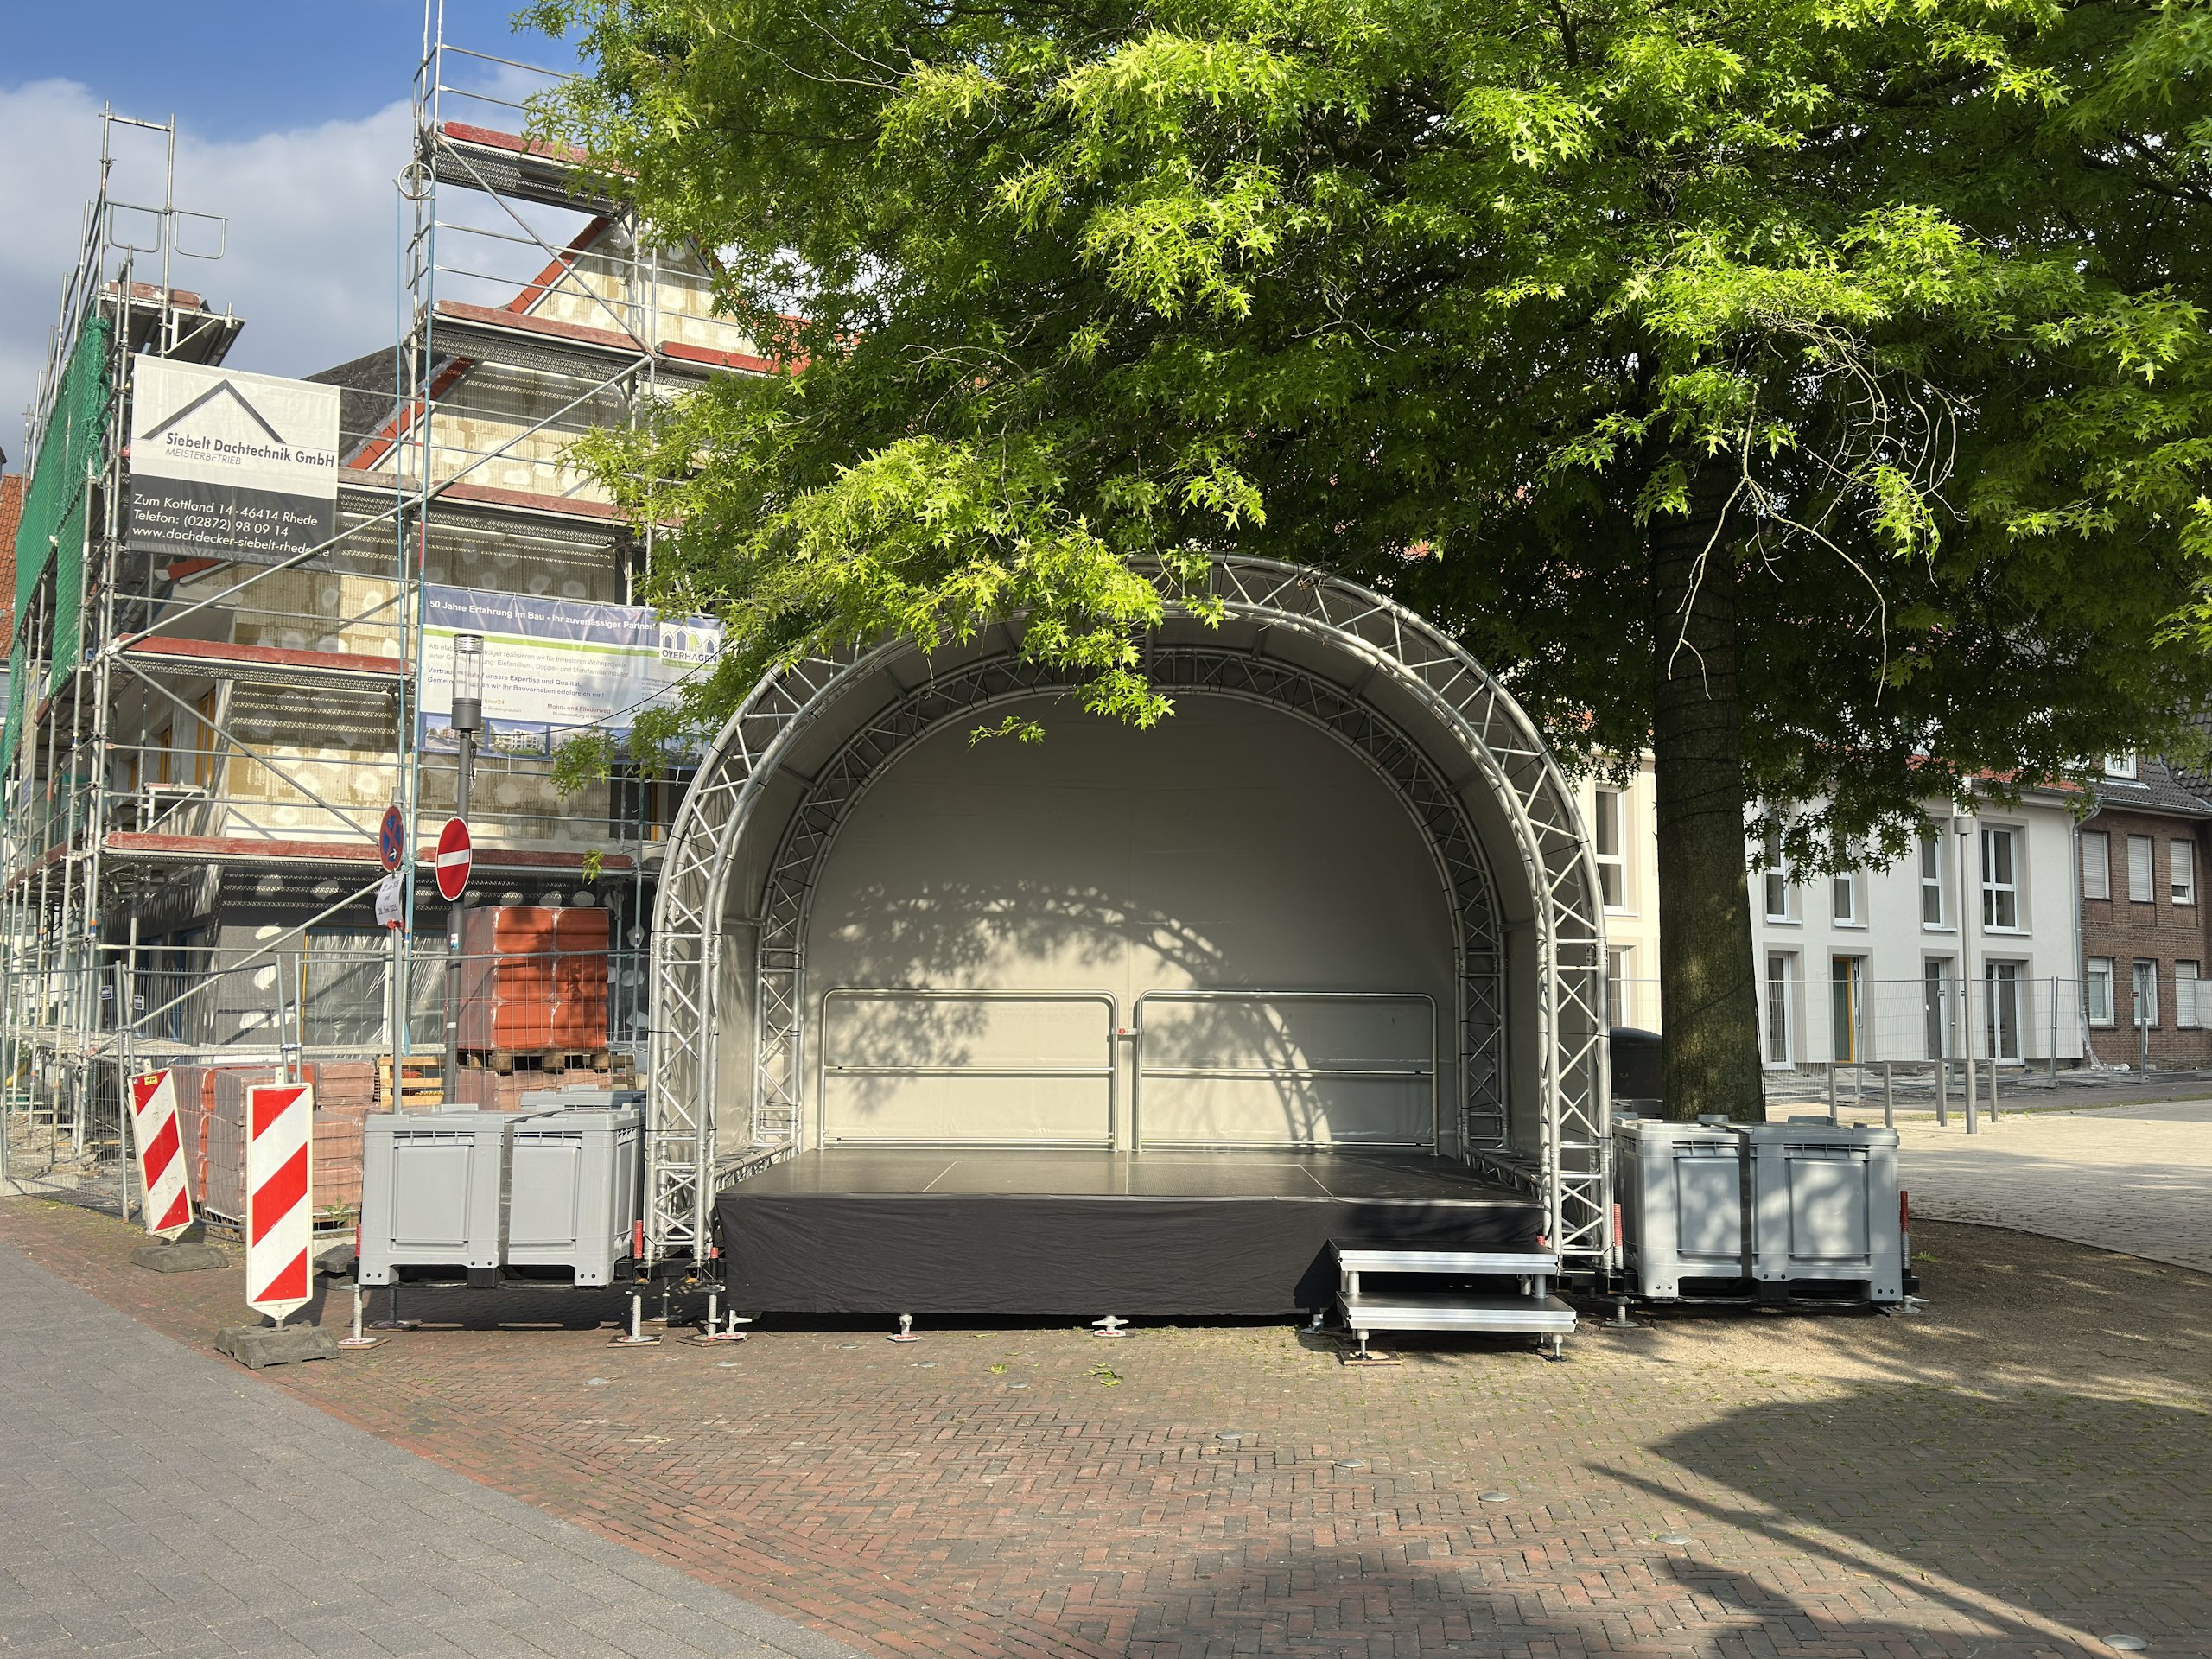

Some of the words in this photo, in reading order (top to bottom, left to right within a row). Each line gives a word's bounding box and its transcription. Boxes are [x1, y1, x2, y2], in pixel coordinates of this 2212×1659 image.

[165, 448, 241, 465] MEISTERBETRIEB
[166, 433, 210, 449] Siebelt
[214, 439, 291, 461] Dachtechnik
[296, 451, 334, 467] GmbH
[133, 494, 160, 506] Zum
[164, 498, 214, 513] Kottland
[220, 505, 233, 515] 14
[240, 507, 279, 521] 46414
[283, 512, 318, 526] Rhede
[134, 509, 179, 524] Telefon:
[184, 515, 231, 532] (02872)
[235, 521, 251, 532] 98
[254, 524, 270, 534] 09
[275, 526, 288, 537] 14
[442, 602, 467, 612] Jahre
[469, 605, 513, 619] Erfahrung
[515, 610, 525, 619] im
[528, 612, 545, 621] Bau
[553, 614, 564, 623] Ihr
[566, 617, 621, 629] zuverlässiger
[623, 621, 656, 630] Partner!
[662, 649, 718, 663] OVERHAGEN
[510, 674, 540, 684] Expertise
[513, 686, 556, 695] Bauvorhaben
[557, 690, 591, 698] erfolgreich
